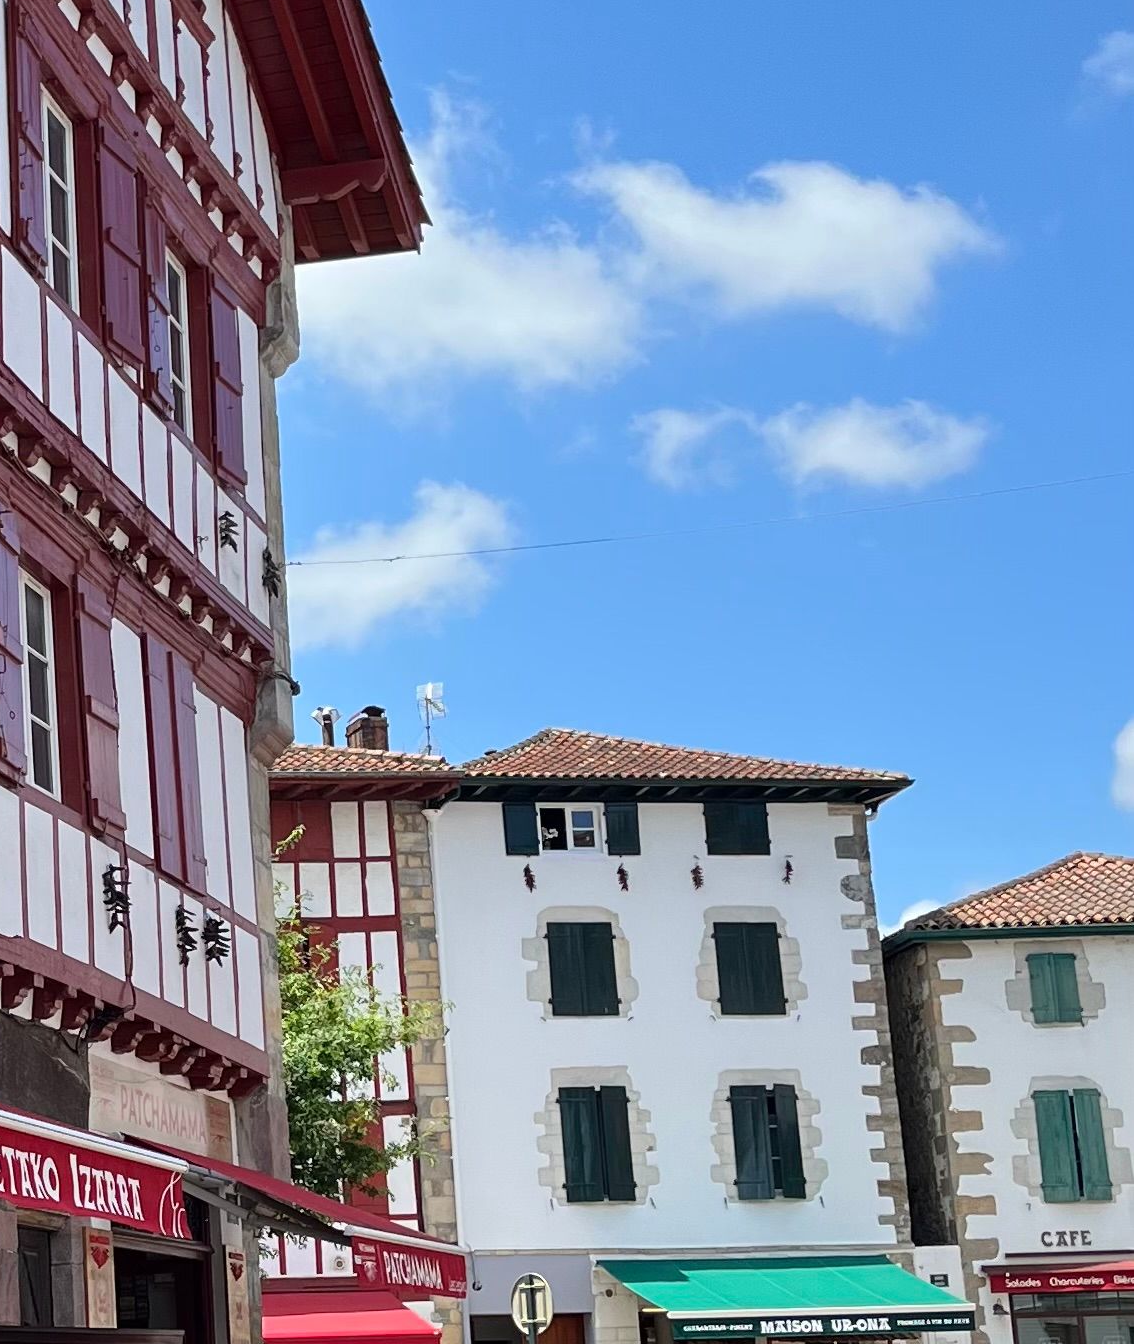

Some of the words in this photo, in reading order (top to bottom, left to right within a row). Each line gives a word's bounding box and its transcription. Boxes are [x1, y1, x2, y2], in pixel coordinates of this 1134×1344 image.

[119, 1084, 208, 1145] PATCHAMAMA
[69, 1154, 145, 1221] IZARRA
[1041, 1230, 1092, 1247] CAFE
[383, 1250, 444, 1290] PATCHAMAMA
[1005, 1277, 1042, 1288] Salades
[1049, 1276, 1105, 1286] Charcuteries
[759, 1319, 824, 1334] MAISON
[831, 1318, 891, 1332] UR-ONA
